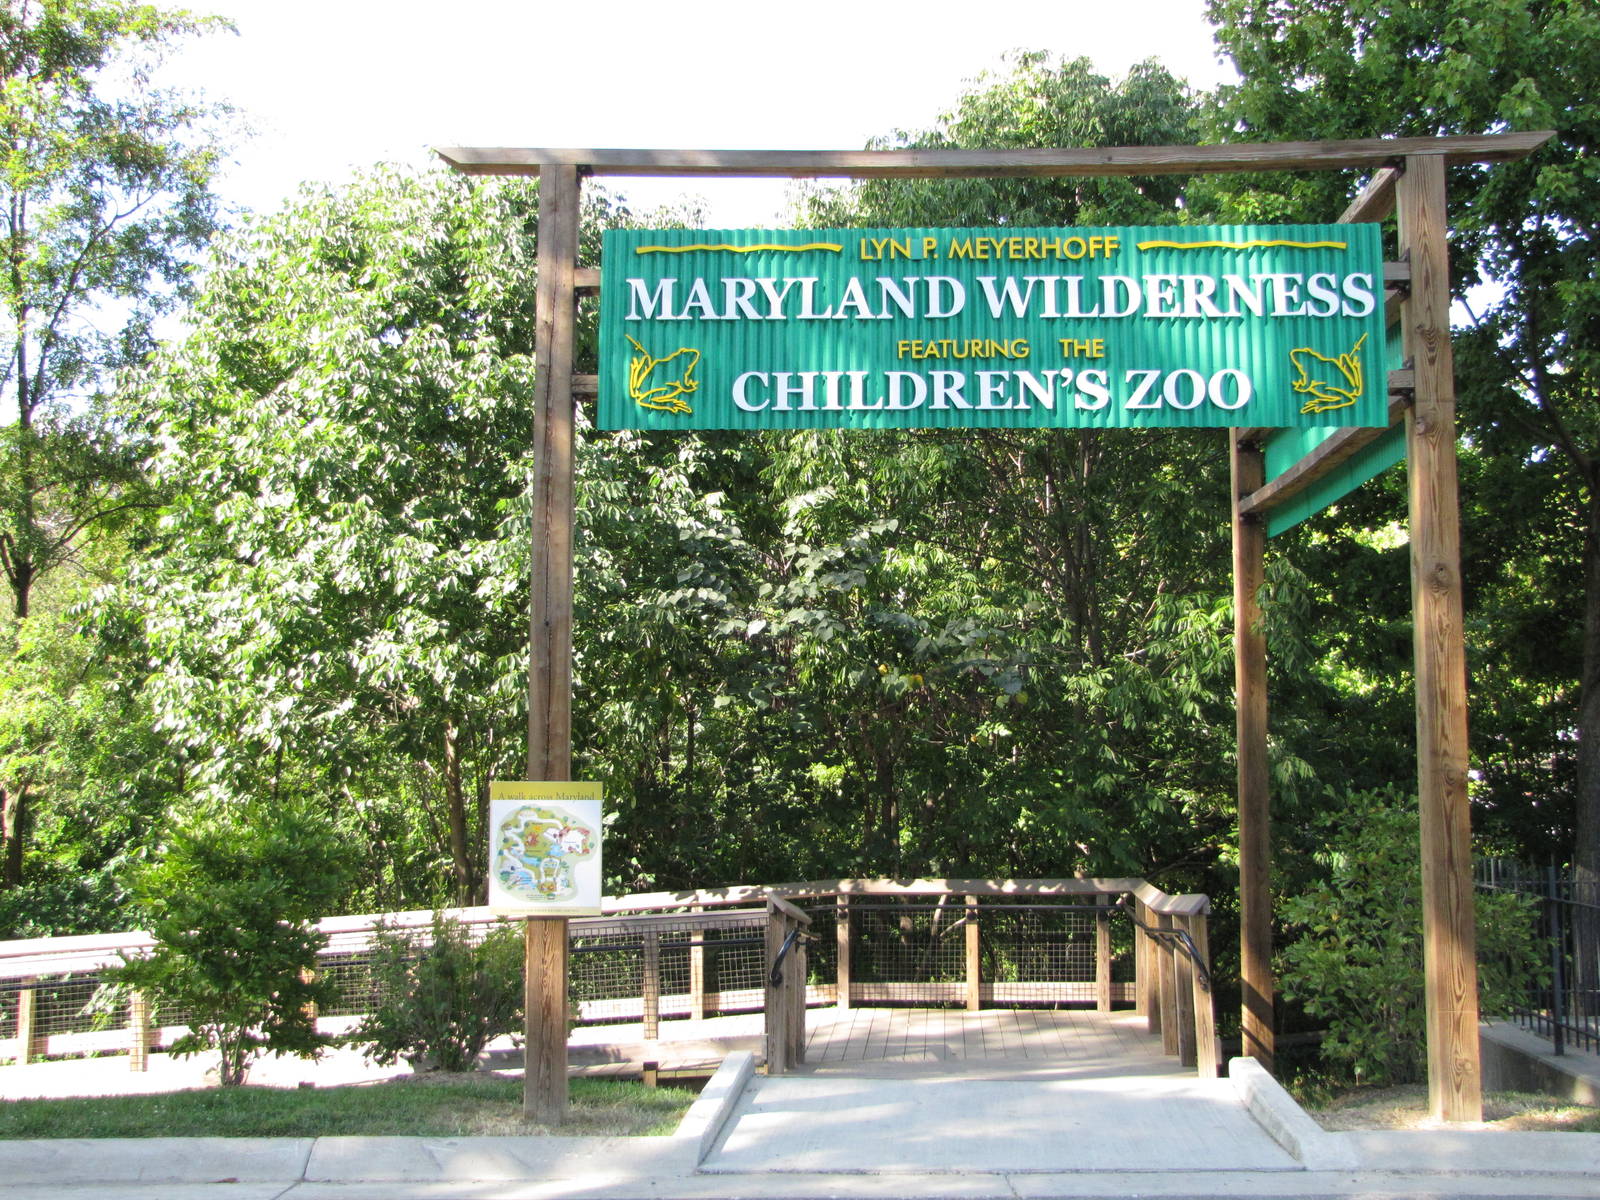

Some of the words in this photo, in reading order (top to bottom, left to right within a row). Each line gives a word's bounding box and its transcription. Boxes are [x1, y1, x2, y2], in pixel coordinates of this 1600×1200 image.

[860, 237, 911, 260] LYN
[923, 237, 938, 260] P.
[948, 236, 1121, 261] MEYERHOFF
[625, 276, 966, 321] MARYLAND
[976, 273, 1375, 319] WILDERNESS
[897, 339, 1030, 360] FEATURING
[1059, 338, 1105, 358] THE
[732, 369, 1107, 412] CHILDREN'S
[1125, 368, 1252, 410] ZOO
[498, 792, 505, 801] A
[507, 792, 525, 801] walk
[528, 793, 553, 801] across
[556, 791, 595, 802] Maryland
